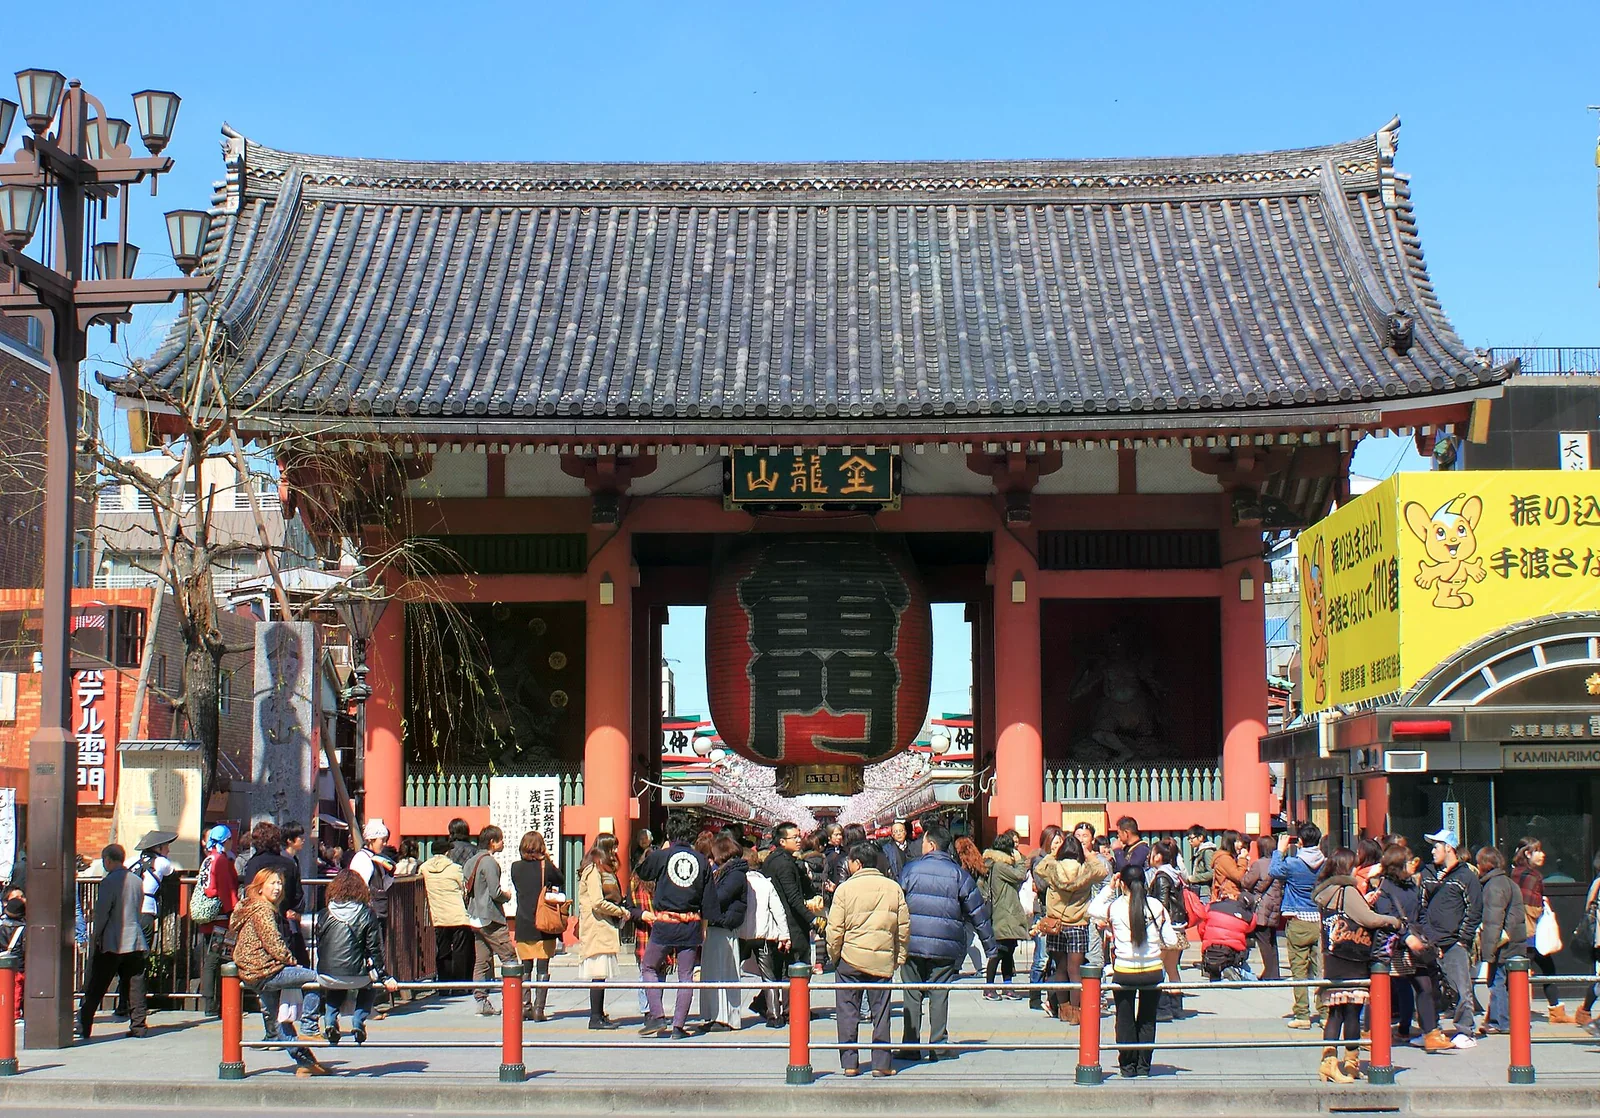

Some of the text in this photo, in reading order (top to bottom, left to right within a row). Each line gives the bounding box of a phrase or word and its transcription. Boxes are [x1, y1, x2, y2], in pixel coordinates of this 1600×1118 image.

[736, 540, 911, 761] 雷門
[1513, 751, 1600, 763] KAMINARIMO
[543, 789, 555, 857] 三社祭斎行
[1332, 920, 1372, 947] Barbie
